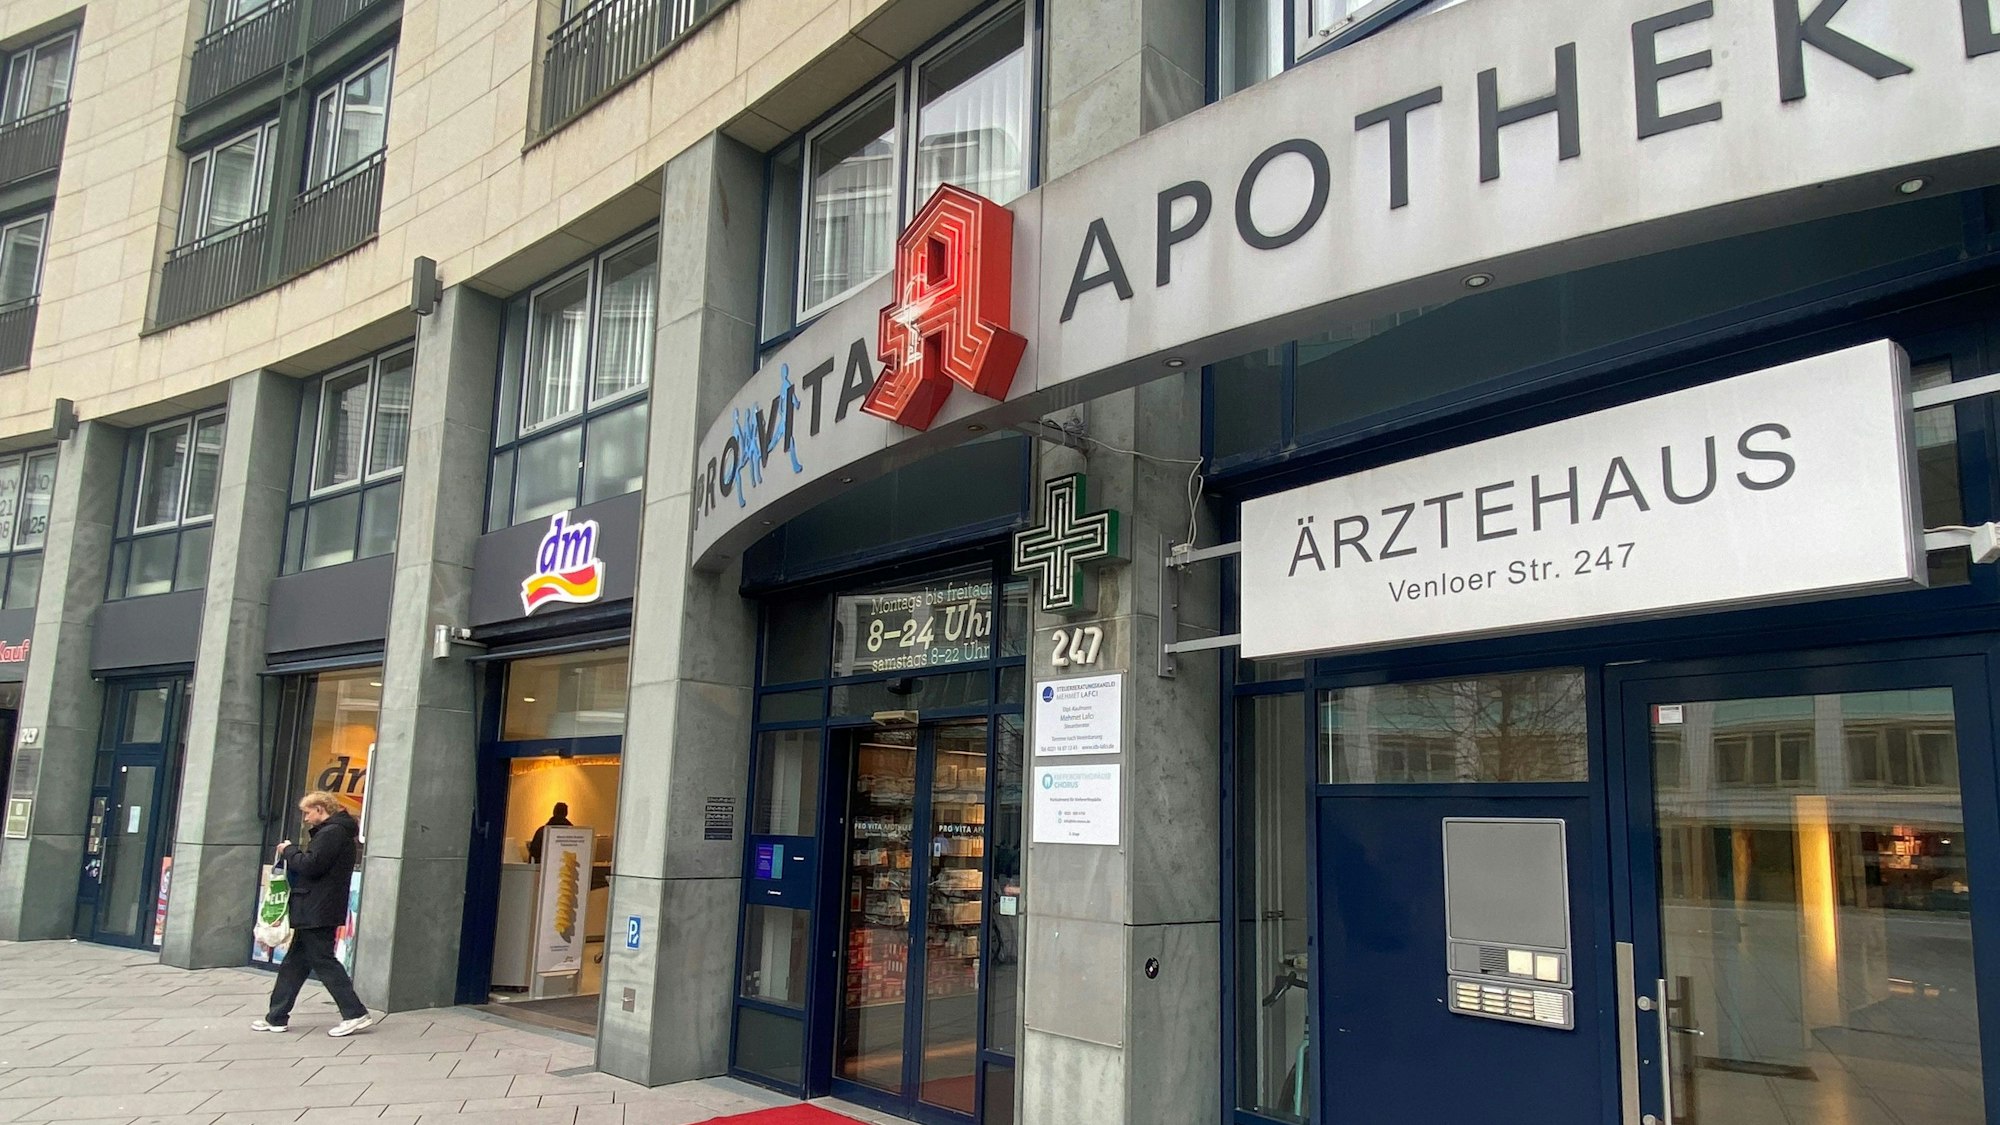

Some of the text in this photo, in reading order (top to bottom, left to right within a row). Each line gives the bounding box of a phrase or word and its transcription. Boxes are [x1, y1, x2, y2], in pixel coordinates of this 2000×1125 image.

[1288, 422, 1796, 577] ÄRZTEHAUS
[540, 517, 592, 574] dm
[1388, 541, 1636, 602] Venloer Str. 247
[871, 594, 921, 616] Montags
[925, 587, 944, 606] bis
[872, 651, 928, 673] samstags
[1052, 626, 1104, 667] 247
[955, 825, 972, 833] VITA
